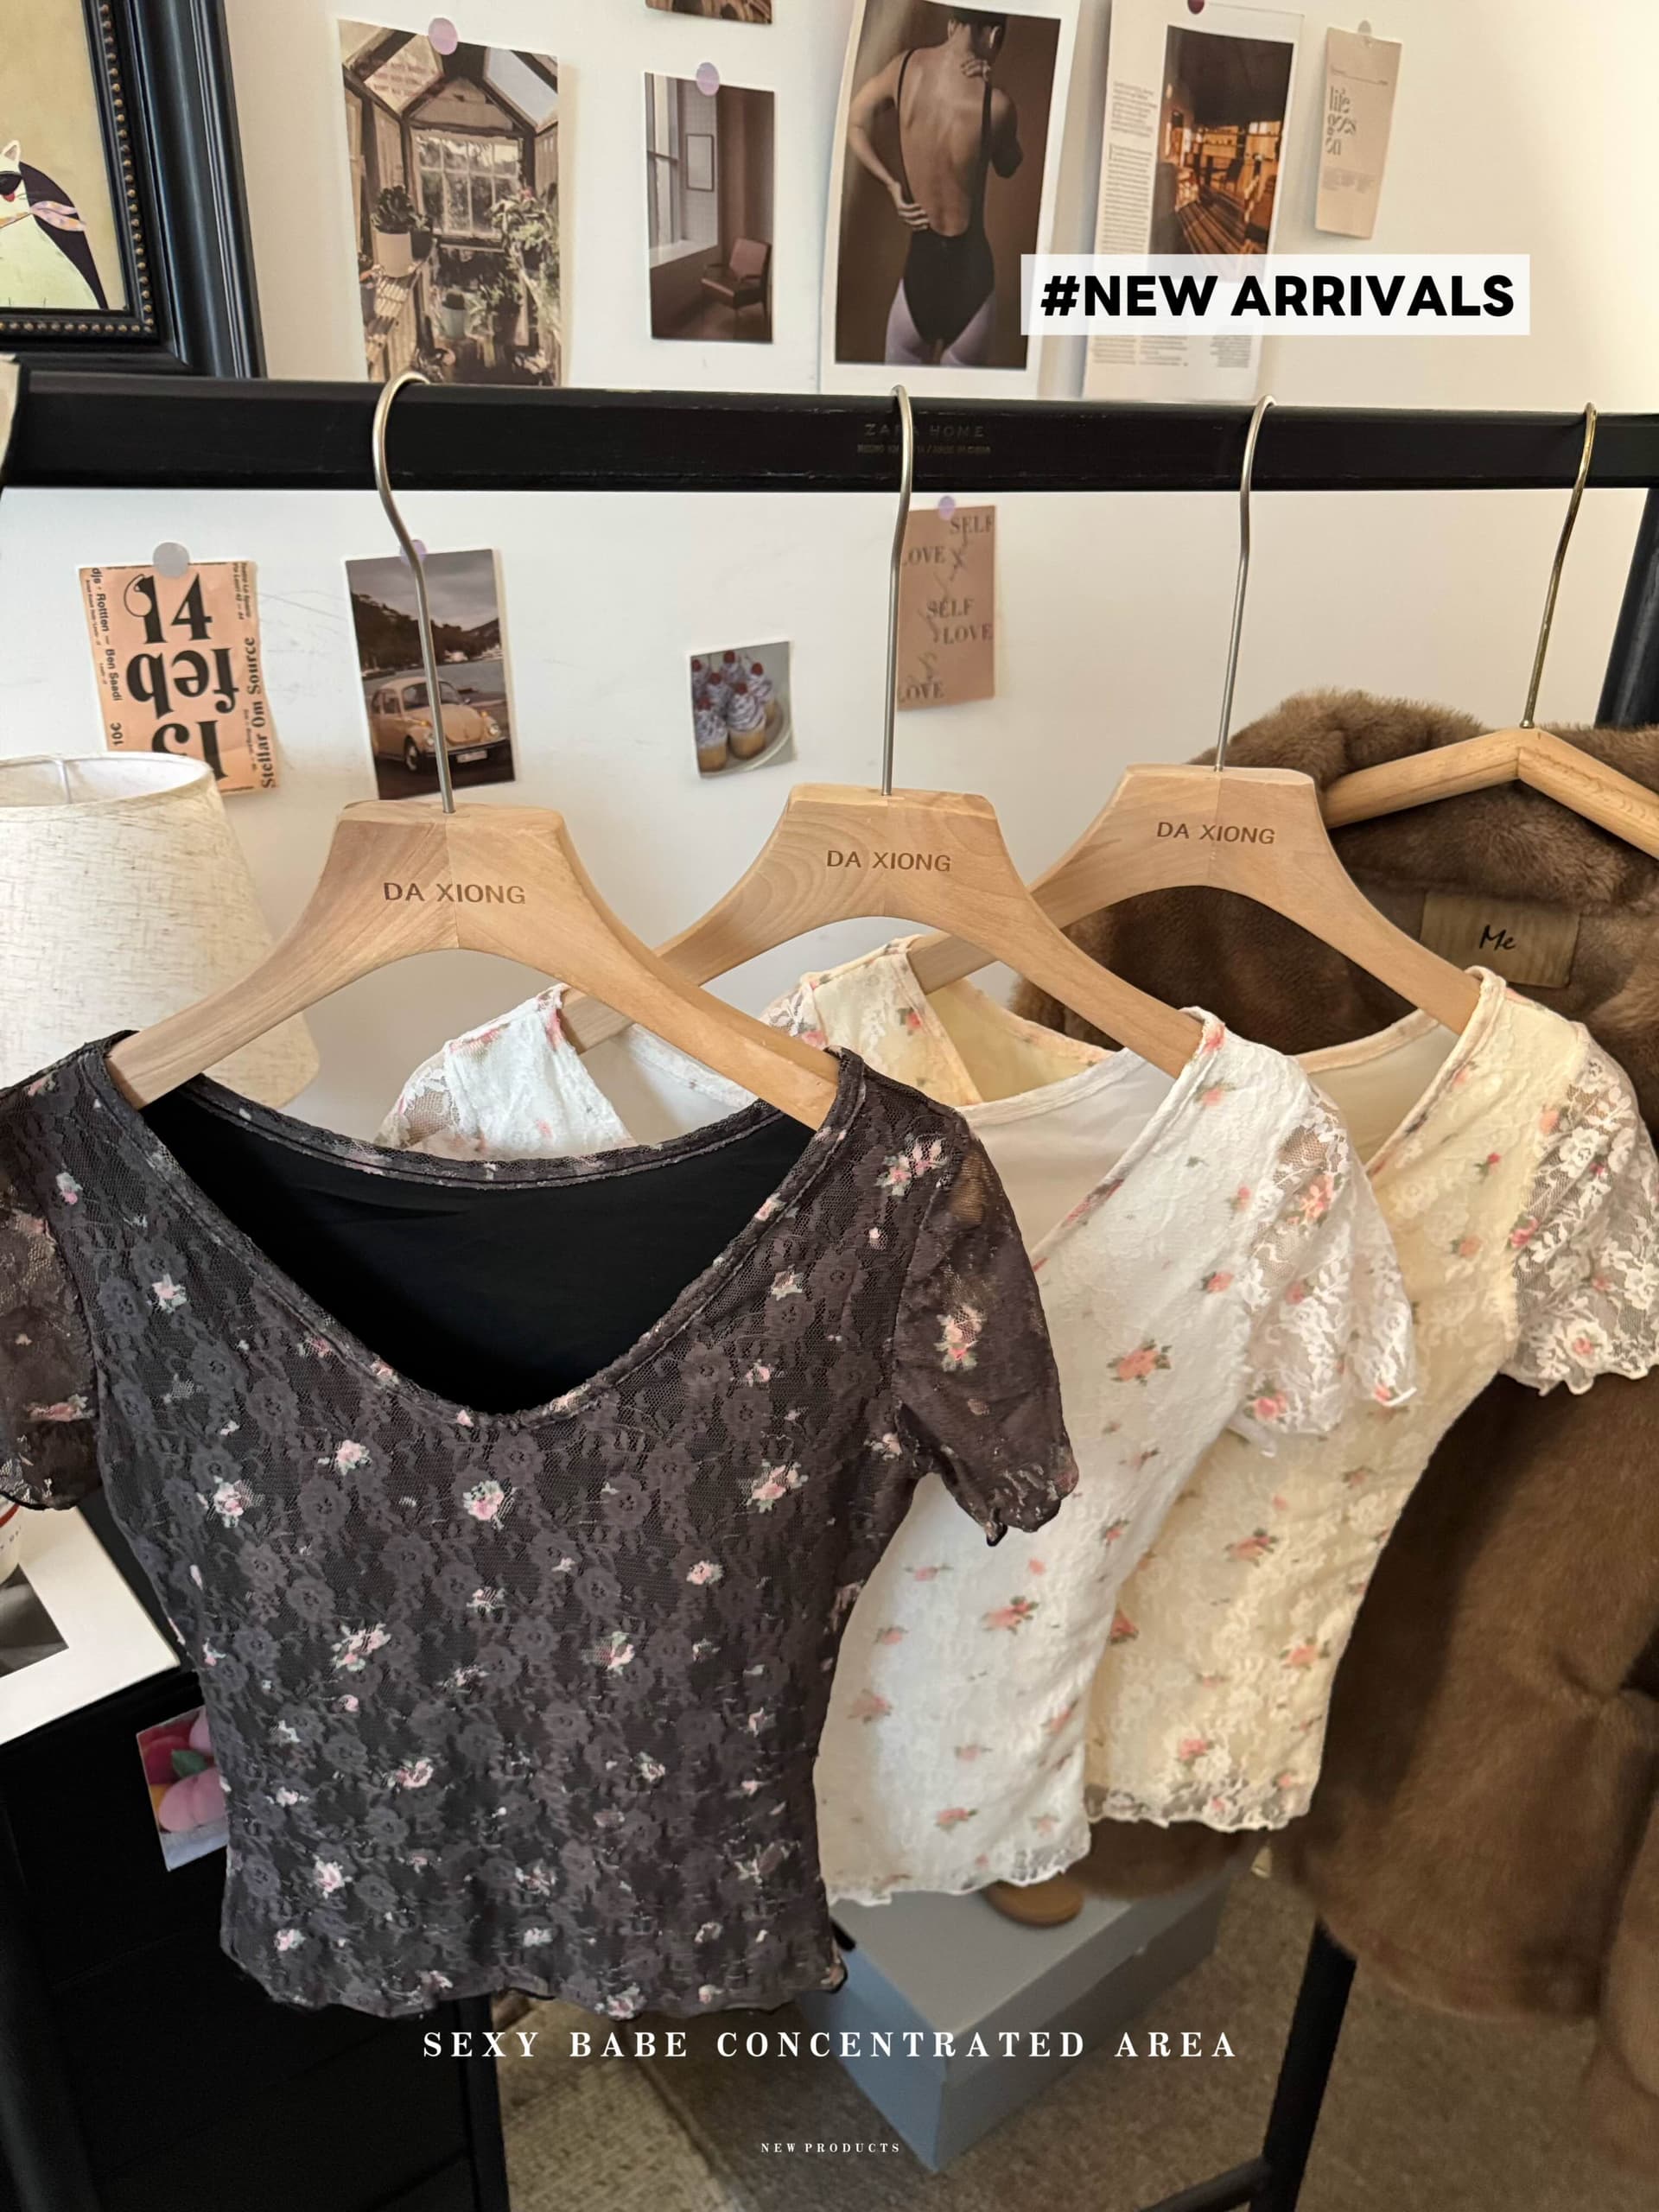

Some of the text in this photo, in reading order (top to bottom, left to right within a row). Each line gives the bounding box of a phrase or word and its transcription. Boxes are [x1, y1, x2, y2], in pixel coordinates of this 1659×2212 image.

[930, 423, 984, 438] HOME
[949, 515, 993, 534] SELF
[901, 545, 947, 567] OVE
[124, 573, 213, 645] 14
[926, 597, 975, 619] SELF
[943, 621, 994, 645] LOVE
[105, 649, 116, 670] Ben
[245, 637, 260, 695] Source
[126, 648, 239, 720] feb
[251, 701, 265, 728] Om
[256, 734, 276, 788] Stellar
[1157, 822, 1275, 844] DA XIONG
[827, 849, 951, 872] DA XIONG
[384, 882, 526, 904] DA XIONG
